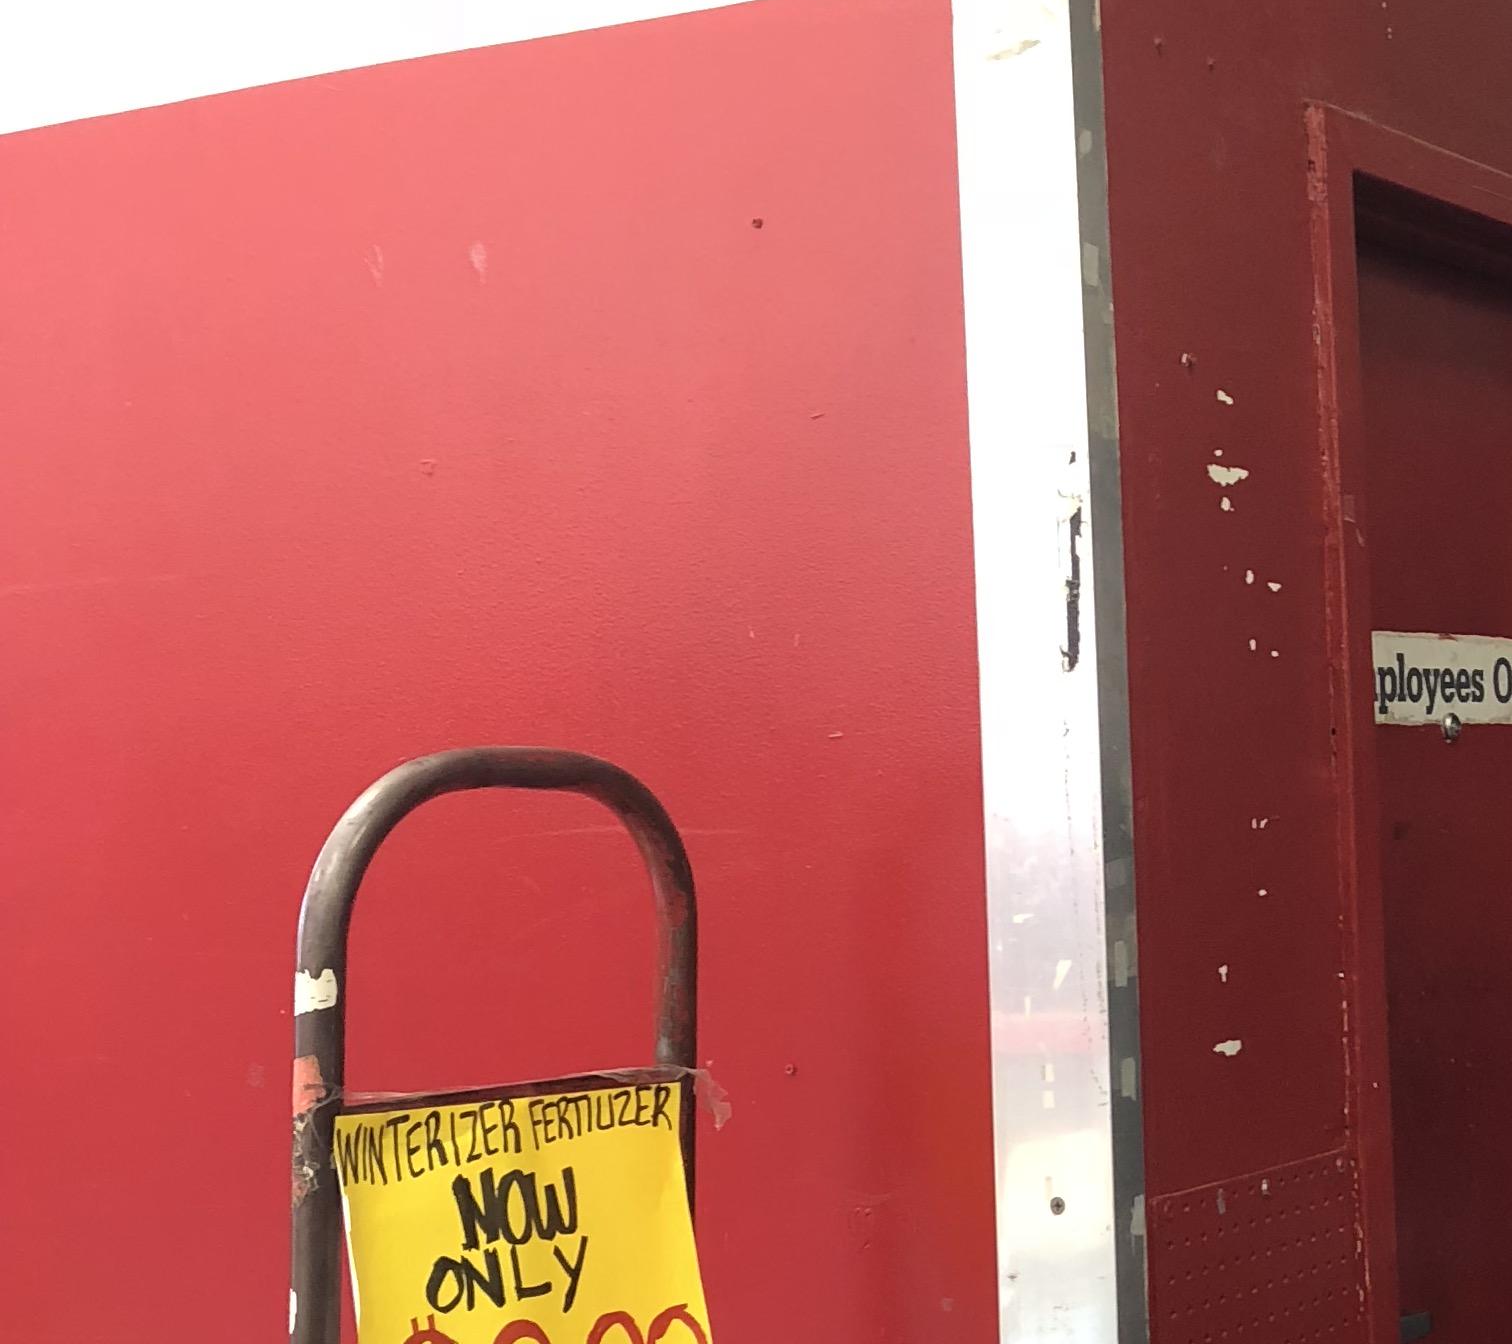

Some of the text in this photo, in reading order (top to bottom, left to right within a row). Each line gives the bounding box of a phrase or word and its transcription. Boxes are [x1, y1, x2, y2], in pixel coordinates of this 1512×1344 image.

[1375, 652, 1484, 715] ployees
[336, 1085, 673, 1187] WINTERIZER FERTILIZER
[452, 1166, 579, 1252] NOW
[425, 1235, 589, 1315] ONLY
